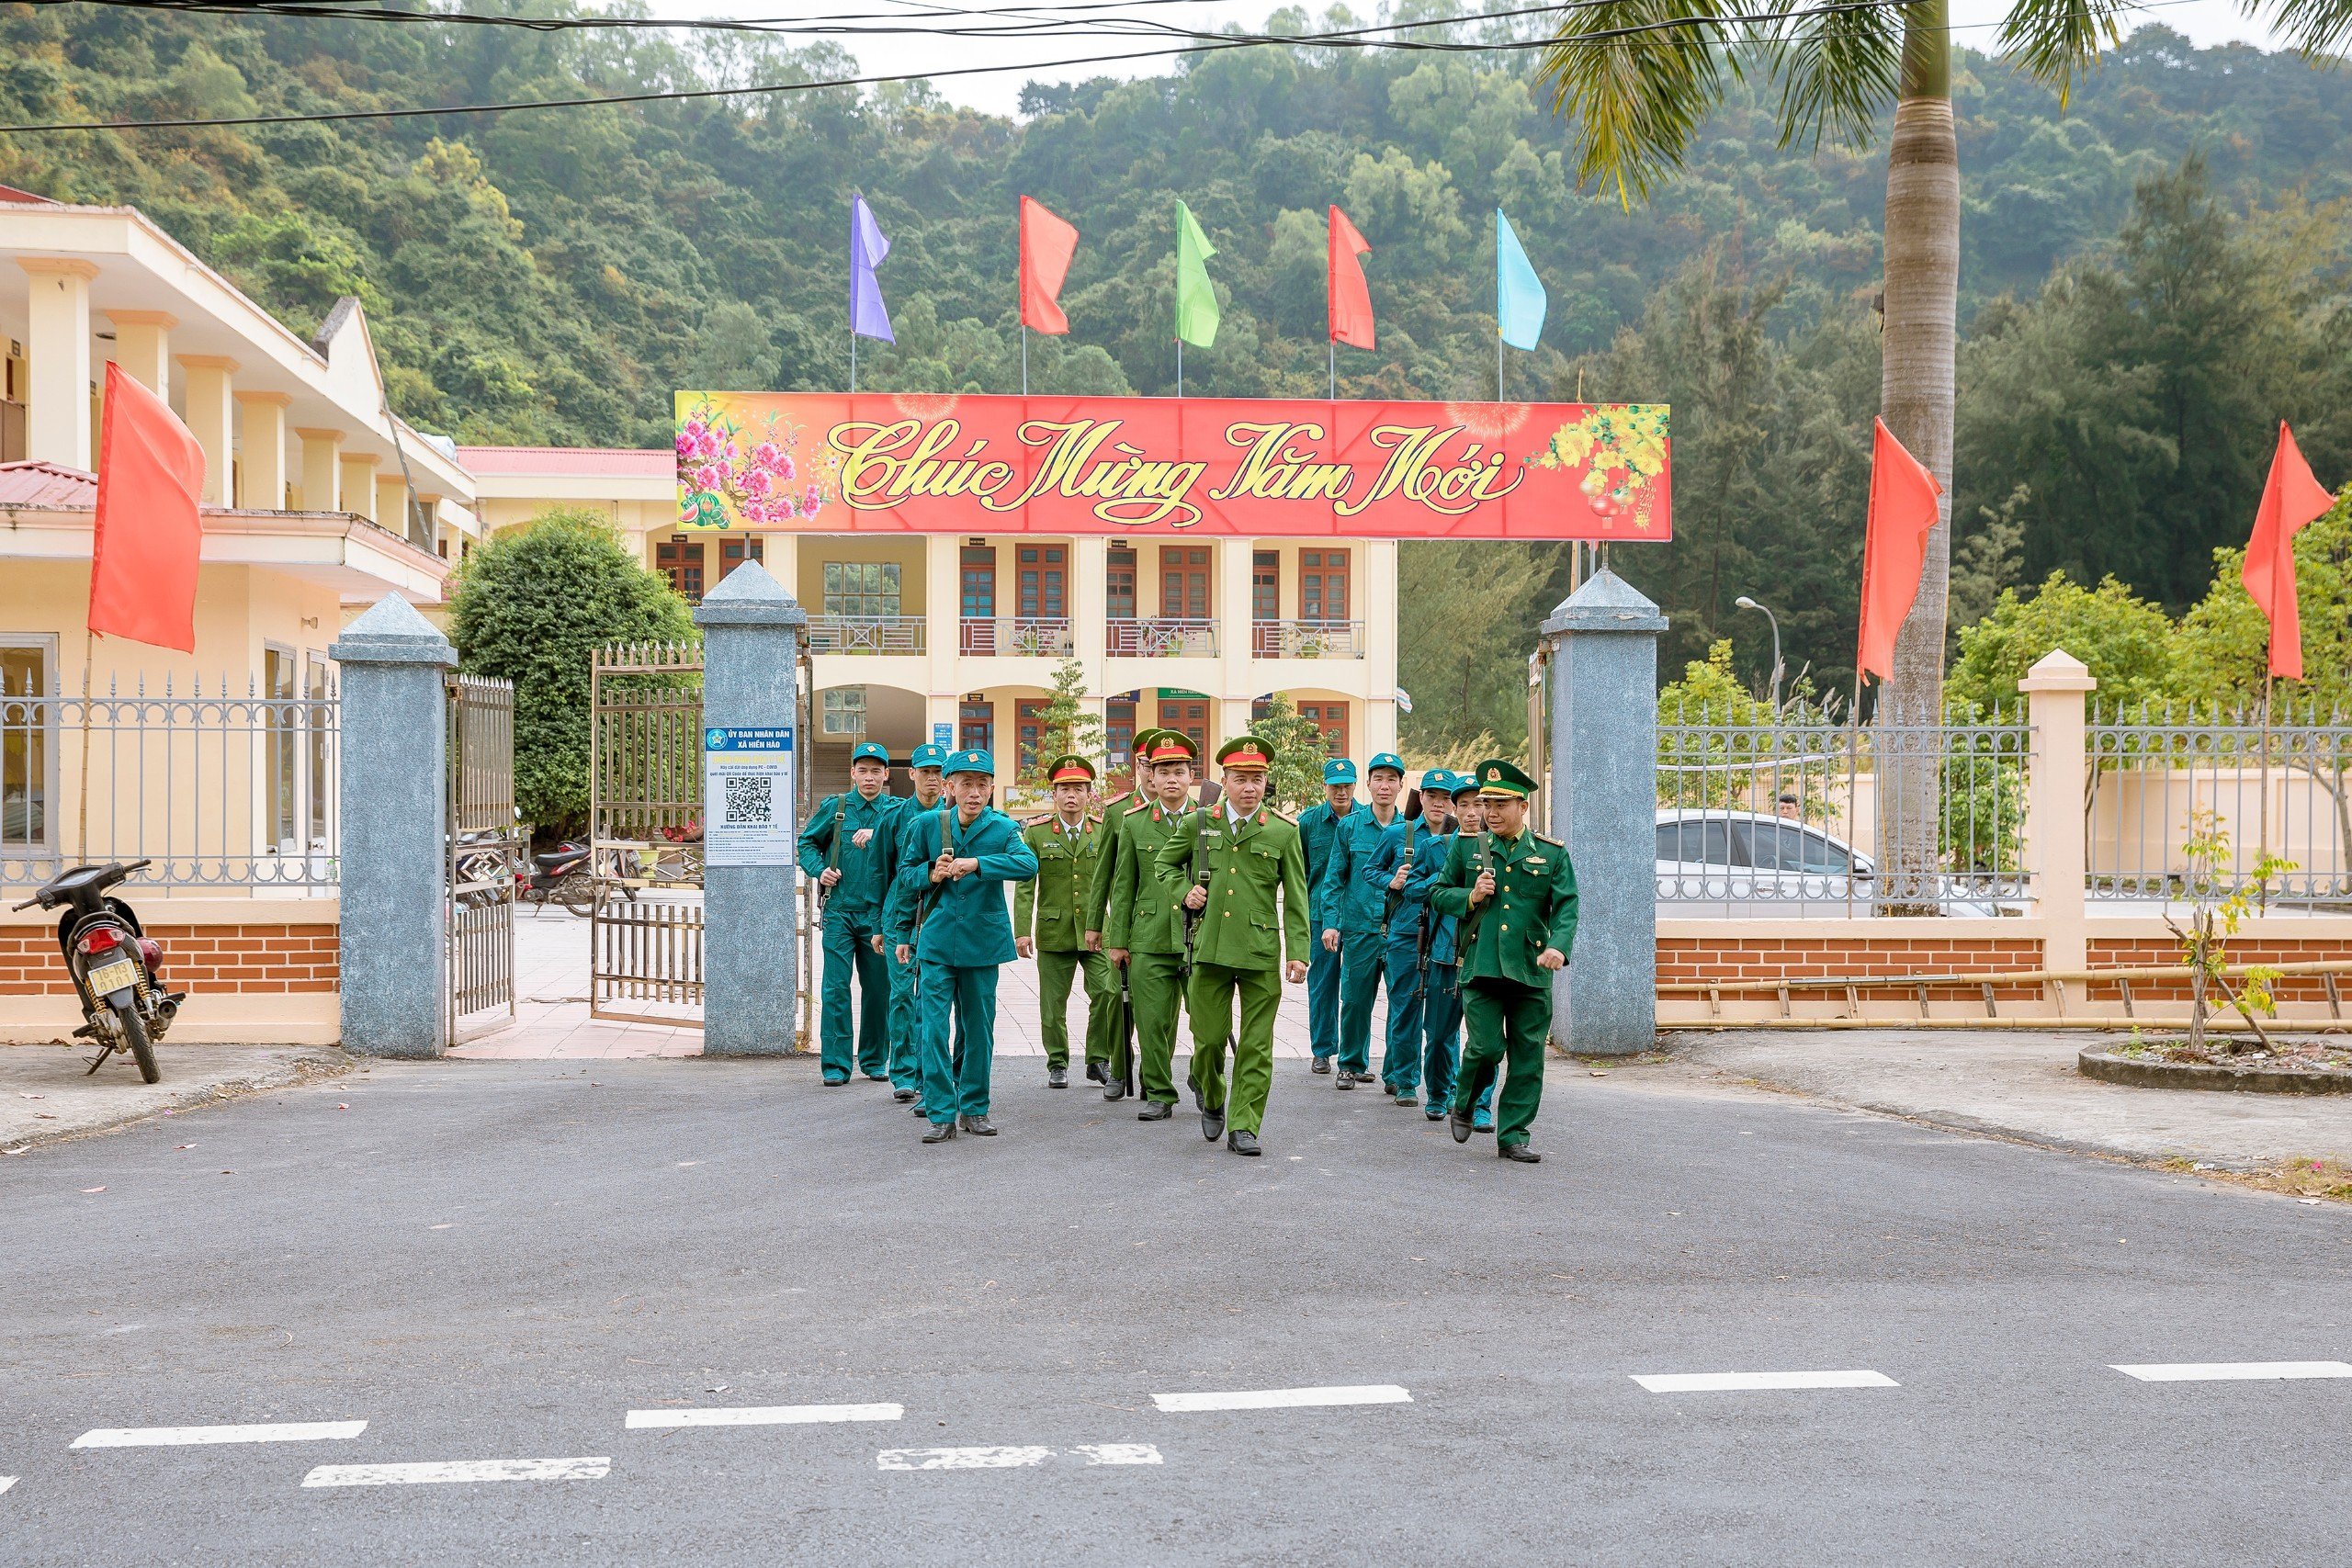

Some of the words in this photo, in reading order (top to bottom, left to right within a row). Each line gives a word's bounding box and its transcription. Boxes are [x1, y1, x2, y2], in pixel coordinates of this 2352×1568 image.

[827, 419, 1014, 511] Chúc
[980, 419, 1208, 528] Mừng
[1208, 421, 1354, 501] Năm
[1332, 424, 1525, 516] Mới
[728, 728, 738, 739] ỦY
[738, 730, 753, 739] BAN
[754, 729, 775, 739] NHÂN
[775, 729, 790, 739] DÂN
[765, 739, 781, 749] HÀO
